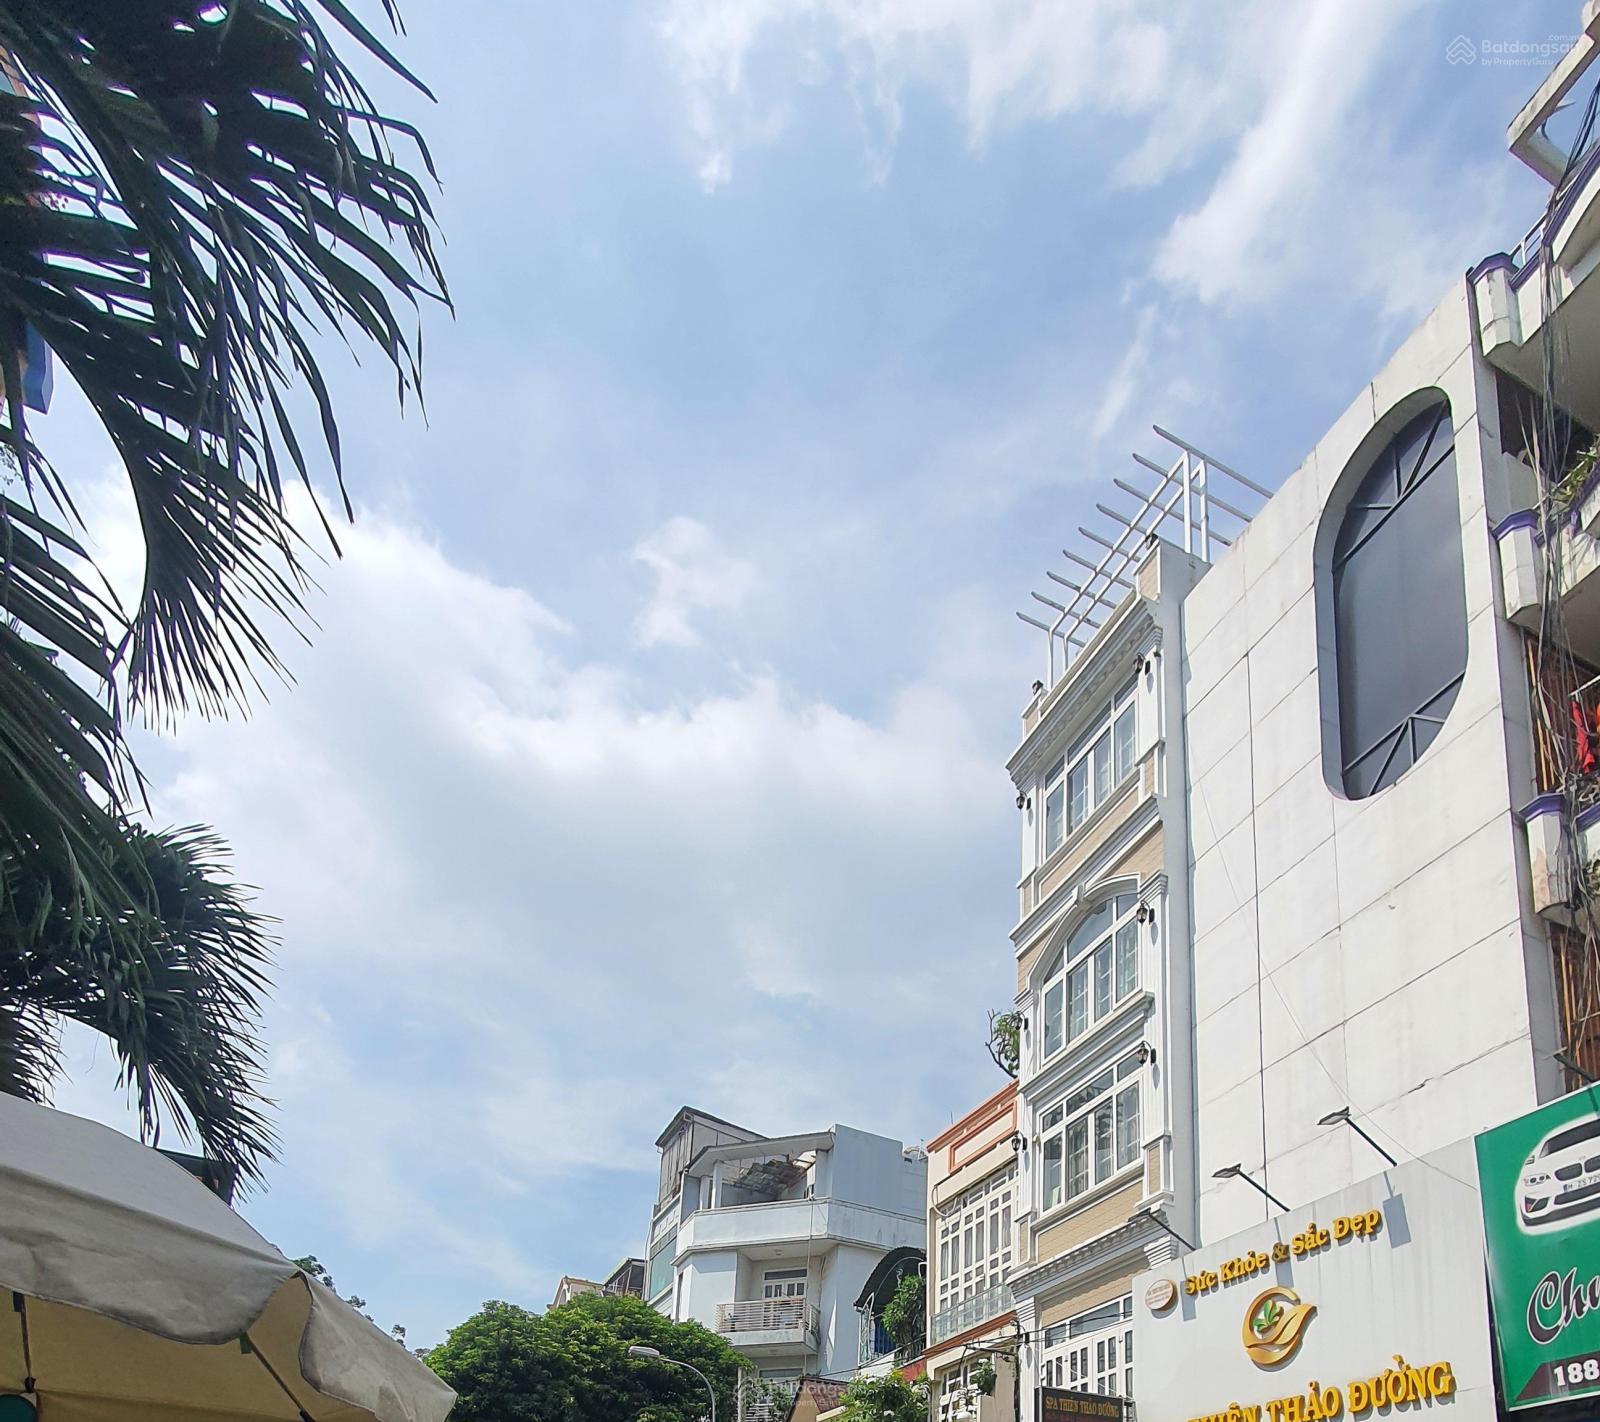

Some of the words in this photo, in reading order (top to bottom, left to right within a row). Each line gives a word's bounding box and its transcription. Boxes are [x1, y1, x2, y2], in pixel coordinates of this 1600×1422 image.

[1219, 1250, 1270, 1283] Khỏe
[1271, 1241, 1290, 1263] &
[1333, 1208, 1383, 1241] Đẹp
[1348, 1354, 1456, 1414] ĐƯỜNG
